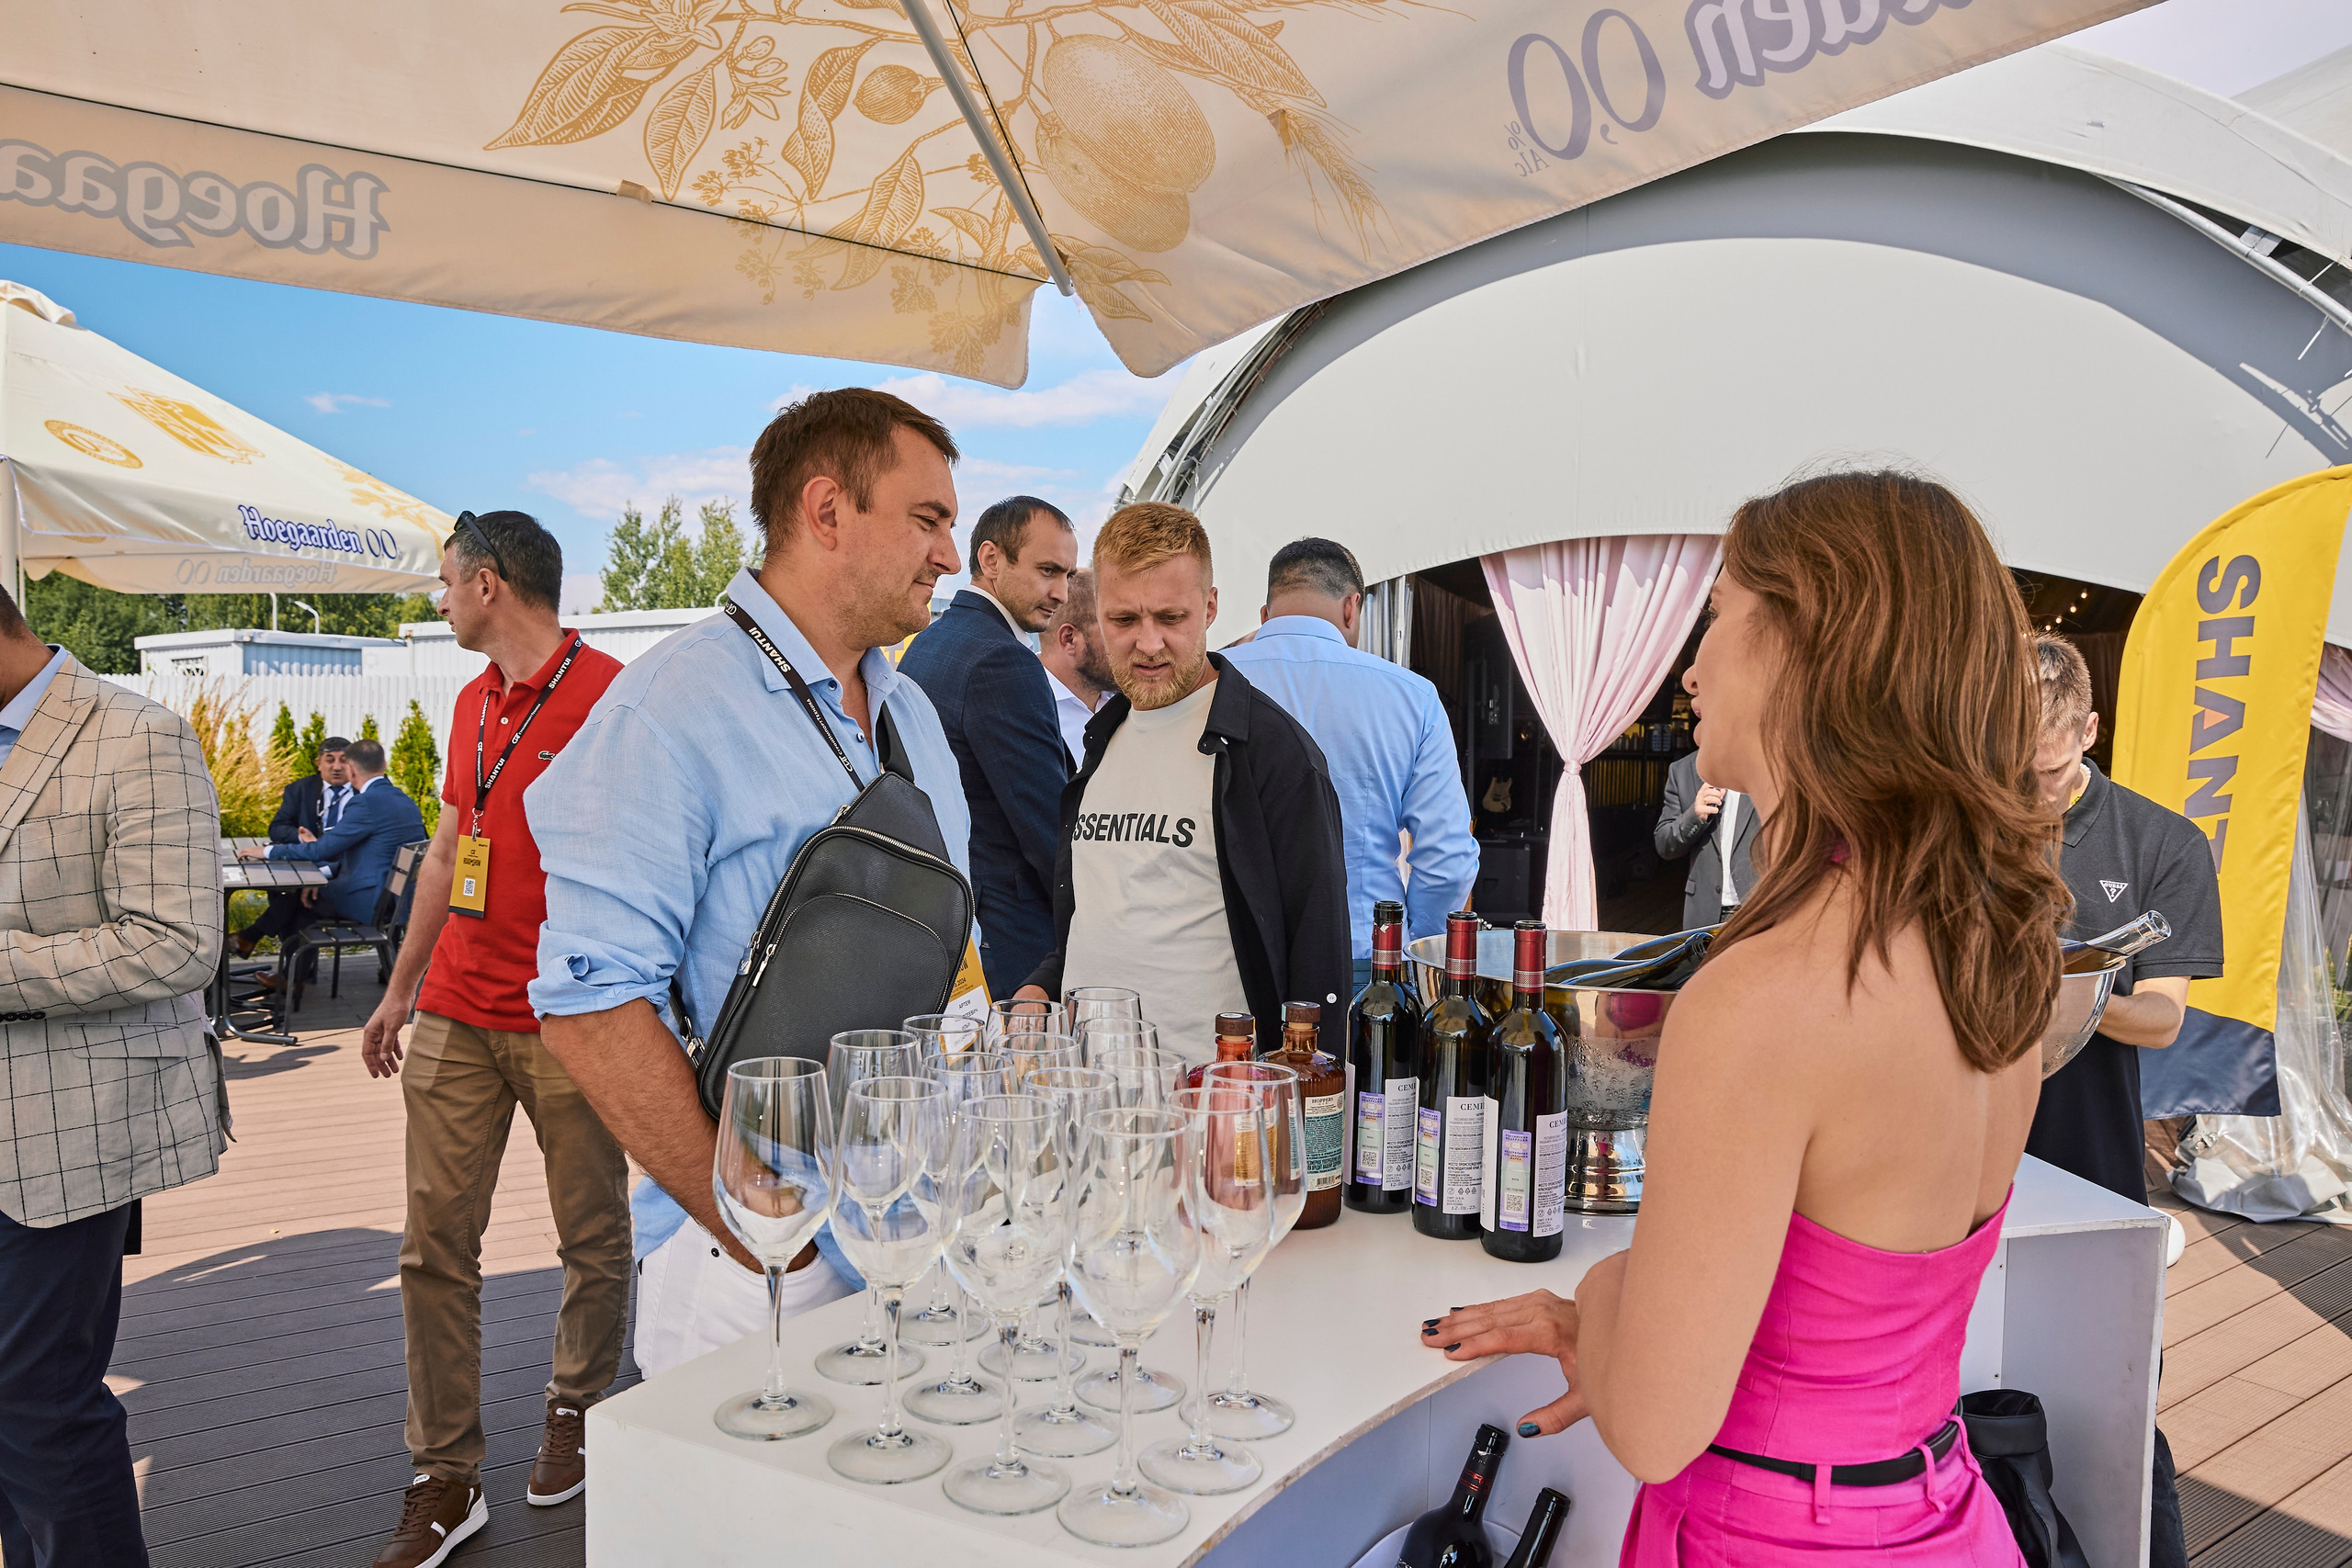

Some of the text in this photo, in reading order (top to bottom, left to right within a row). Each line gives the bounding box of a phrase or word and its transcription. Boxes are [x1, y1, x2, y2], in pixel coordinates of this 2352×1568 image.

[238, 504, 365, 555] Hoegaarden
[749, 626, 791, 673] SHANTUI
[548, 657, 571, 690] SHANTUI
[484, 757, 506, 790] SHANTUI
[1073, 813, 1196, 848] SSENTIALS
